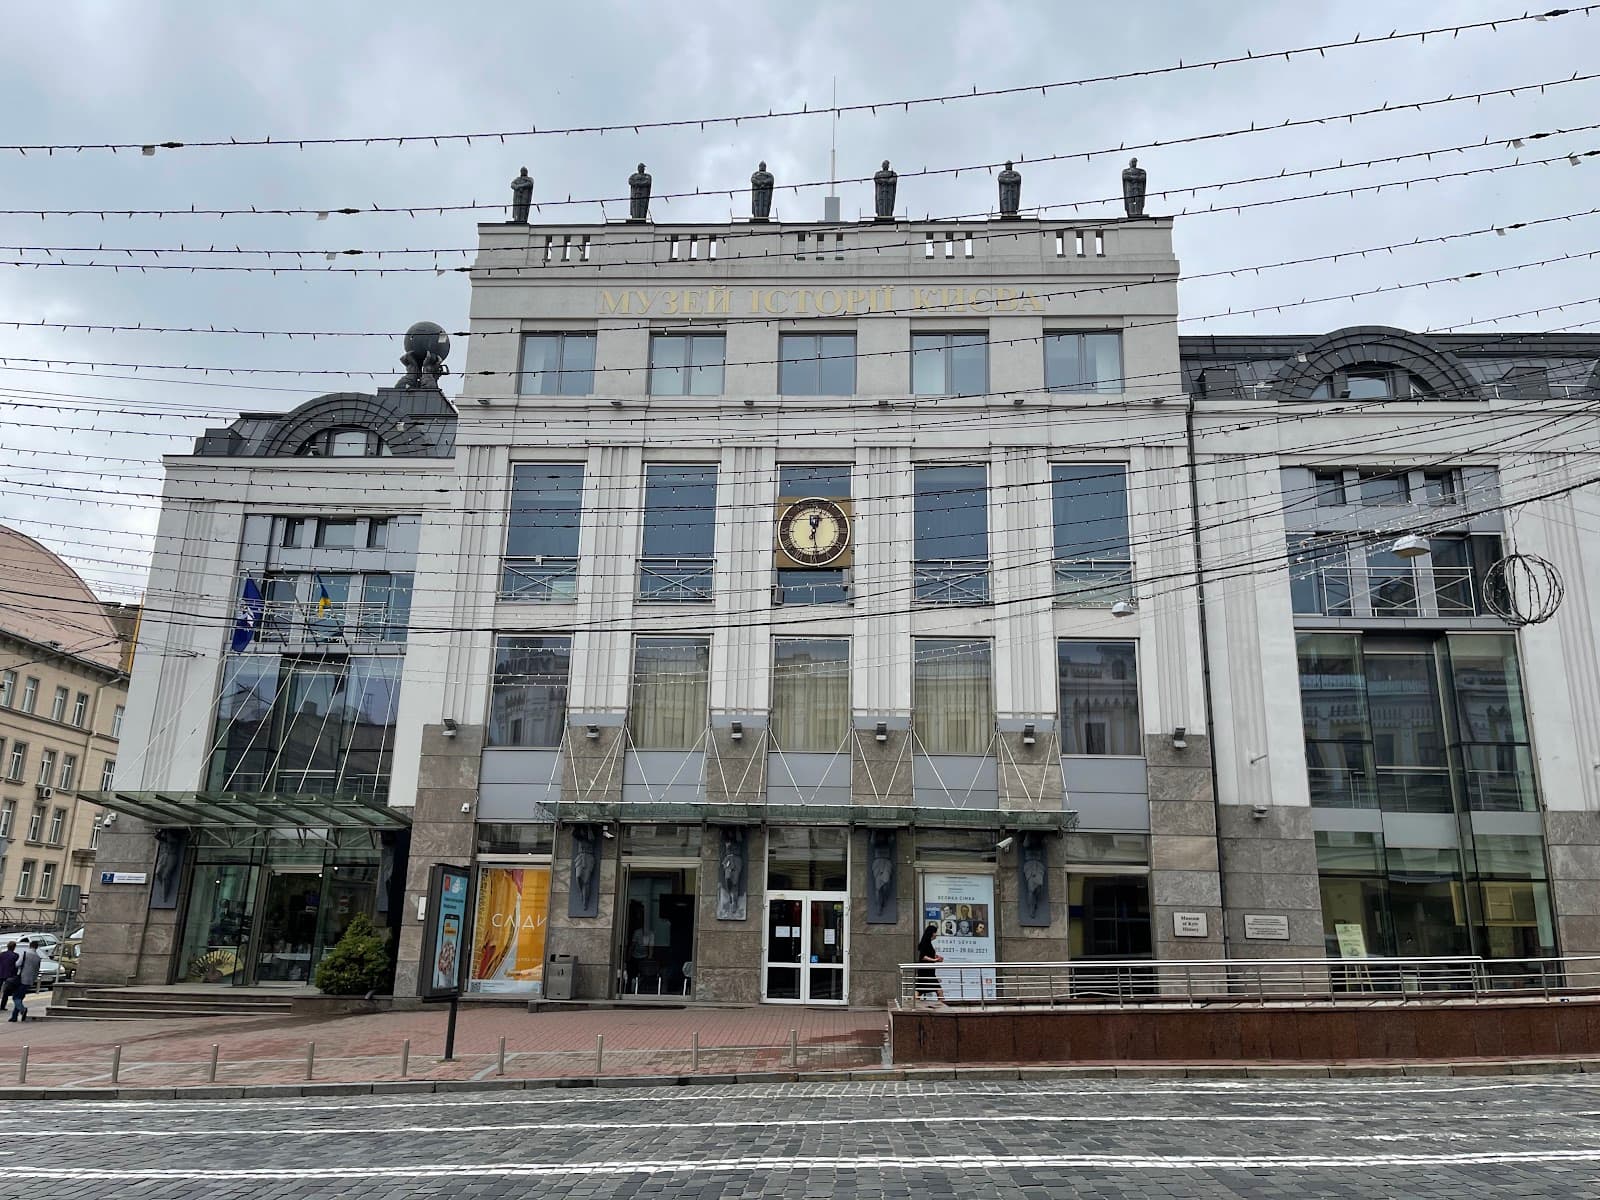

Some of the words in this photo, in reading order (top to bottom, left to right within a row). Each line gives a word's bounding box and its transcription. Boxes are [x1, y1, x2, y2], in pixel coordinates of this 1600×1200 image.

[597, 284, 734, 315] МУЗЕЙ
[747, 285, 896, 314] ІСТОРІЇ
[911, 286, 1047, 314] КИЄВА
